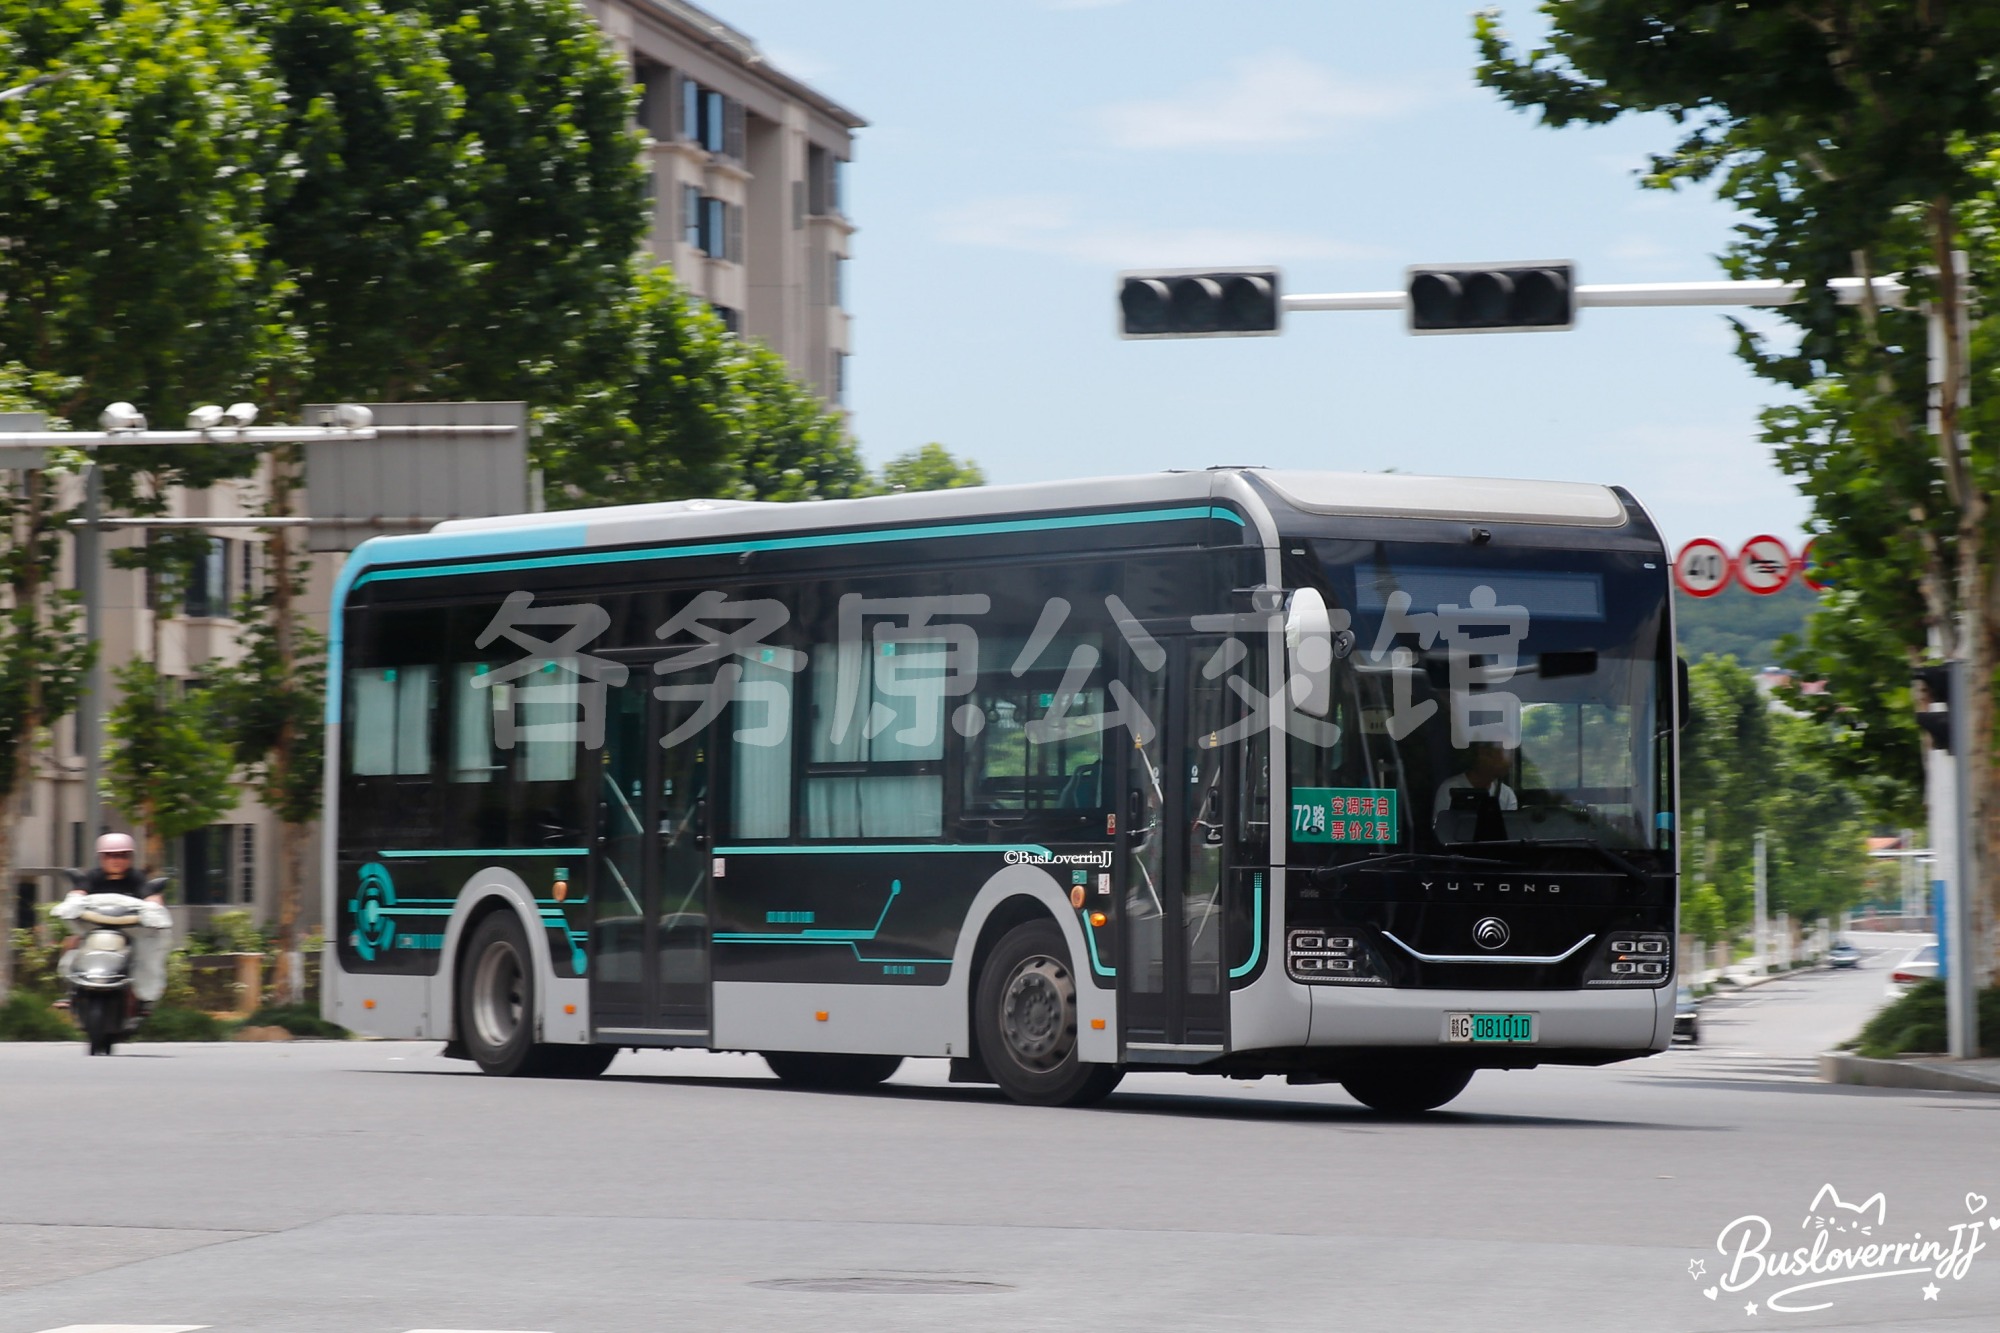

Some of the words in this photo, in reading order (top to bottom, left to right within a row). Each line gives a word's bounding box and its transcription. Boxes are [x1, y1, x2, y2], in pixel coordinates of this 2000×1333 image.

[1331, 796, 1389, 816] 空调开启
[1293, 804, 1325, 832] 72路
[1331, 820, 1390, 840] 票价2元
[1421, 882, 1560, 893] YUTONG
